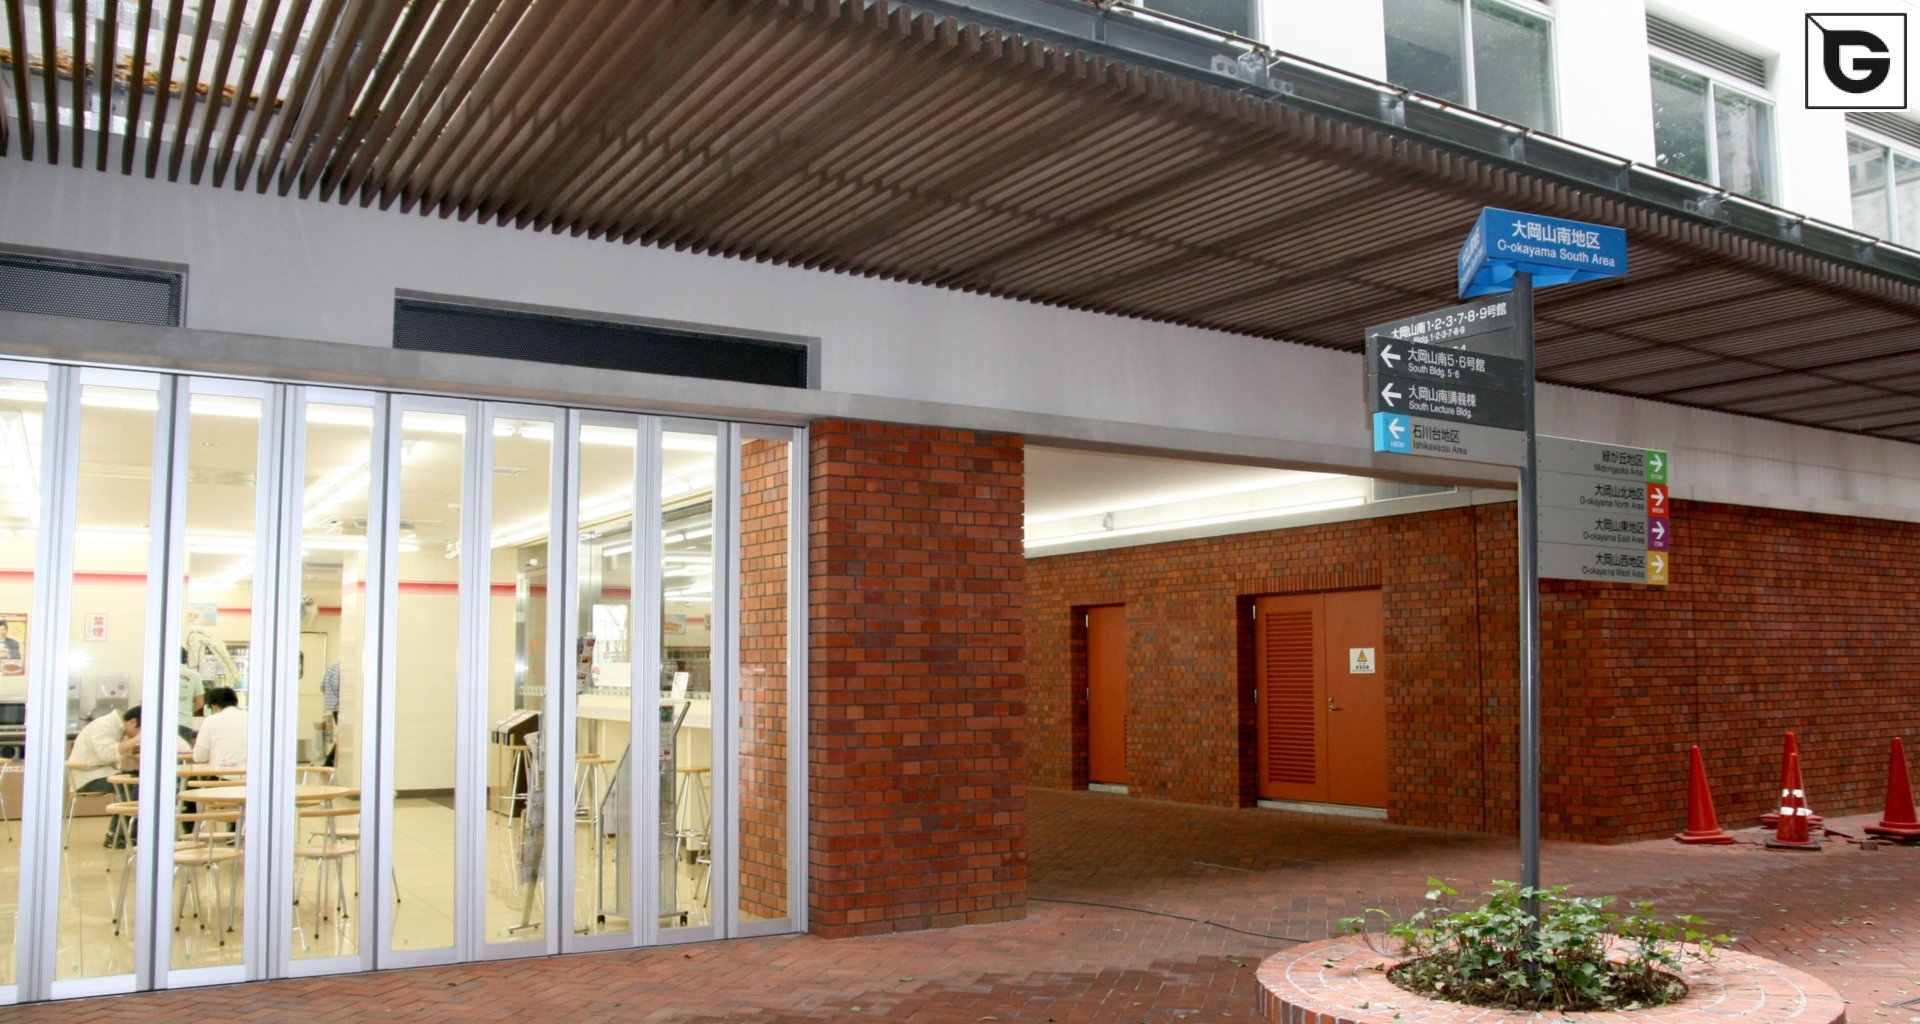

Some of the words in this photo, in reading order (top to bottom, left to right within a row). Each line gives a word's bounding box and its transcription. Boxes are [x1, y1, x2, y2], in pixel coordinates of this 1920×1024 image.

[1511, 220, 1600, 250] 大岡山南地区
[1498, 239, 1556, 259] O-okayama
[1560, 248, 1589, 263] South
[1592, 254, 1615, 267] Area
[1408, 363, 1428, 374] South
[1429, 367, 1446, 378] Bldg.
[1408, 385, 1477, 407] 大岡山南講義棟
[1408, 401, 1429, 412] South
[1430, 404, 1454, 415] Lecture
[1456, 408, 1473, 419] Bldg.
[1412, 424, 1460, 443] 石川台地区
[1413, 440, 1450, 453] Ishikawadai
[1452, 446, 1467, 455] Area
[1602, 450, 1643, 467] 緑が丘地区
[1594, 463, 1629, 475] Midorigaoka
[1630, 468, 1643, 477] Area
[1594, 483, 1644, 500] 大岡山北地区
[1580, 496, 1613, 508] O-okayama
[1614, 499, 1630, 508] North
[1632, 501, 1644, 510] Area
[1595, 518, 1644, 534] 大岡山東地区
[1583, 531, 1616, 542] O-okayama
[1618, 534, 1630, 542] East
[1595, 553, 1644, 568] 大岡山西地区
[1582, 566, 1616, 577] O-okayama
[1617, 568, 1630, 577] West
[1632, 569, 1644, 578] Area
